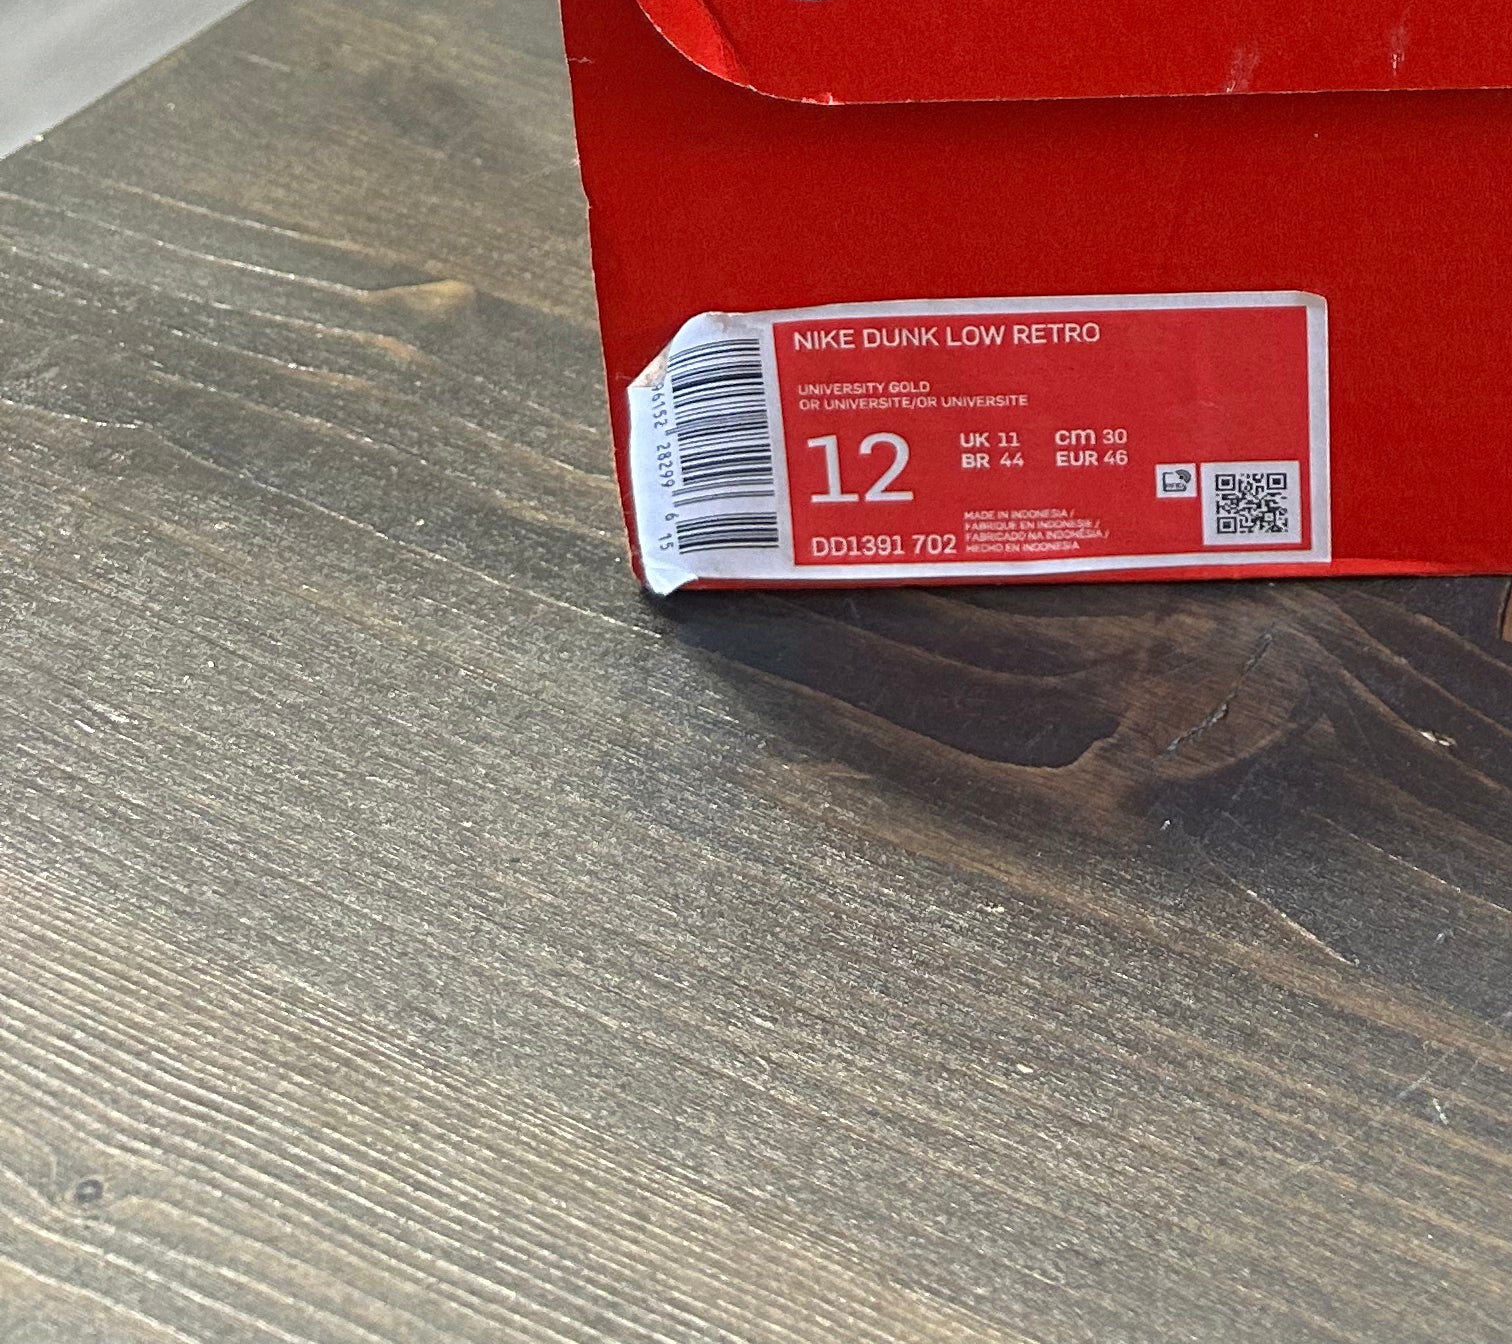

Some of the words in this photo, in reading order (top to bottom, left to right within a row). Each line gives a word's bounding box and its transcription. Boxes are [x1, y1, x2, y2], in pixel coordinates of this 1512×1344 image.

[793, 328, 856, 351] NIKE
[863, 326, 939, 348] DUNK
[946, 324, 1006, 347] LOW
[1013, 322, 1101, 346] RETRO
[798, 382, 885, 396] UNIVERSITY
[888, 381, 930, 394] GOLD
[799, 399, 820, 411] OR
[824, 396, 937, 410] UNIVERSITE/OR
[941, 394, 1028, 408] UNIVERSITE
[960, 432, 990, 448] UK
[998, 432, 1021, 448] 11
[1055, 429, 1096, 446] cm
[1102, 429, 1128, 445] 30
[656, 441, 676, 489] 28299
[961, 453, 991, 469] BR
[999, 452, 1024, 468] 44
[1055, 451, 1099, 467] EUR
[1103, 450, 1129, 466] 46
[807, 432, 914, 503] 12
[964, 511, 995, 520] MADE
[658, 532, 675, 552] 15
[811, 535, 905, 557] DD1391
[911, 534, 957, 555] 702
